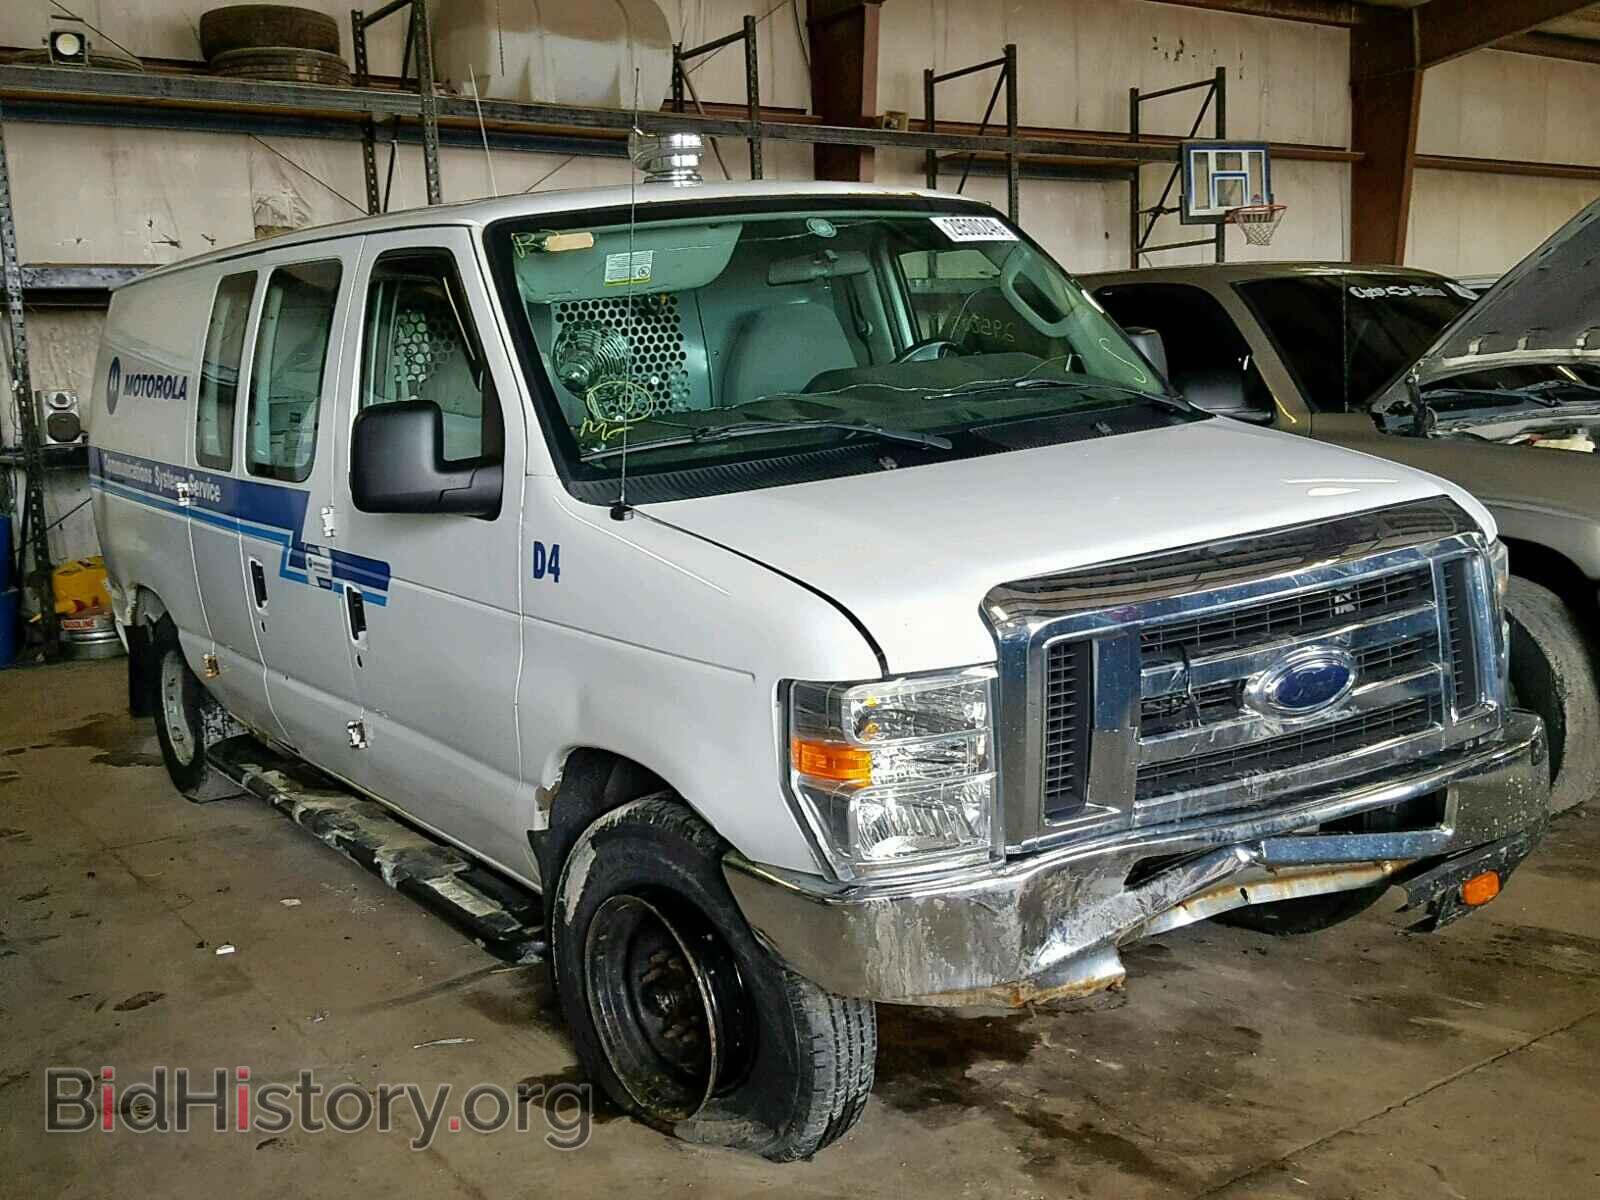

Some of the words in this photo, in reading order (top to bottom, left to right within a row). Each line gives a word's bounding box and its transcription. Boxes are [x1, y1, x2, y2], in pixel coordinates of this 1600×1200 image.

[123, 374, 187, 400] MOTOROLA
[188, 473, 221, 503] Service
[533, 540, 560, 583] D4
